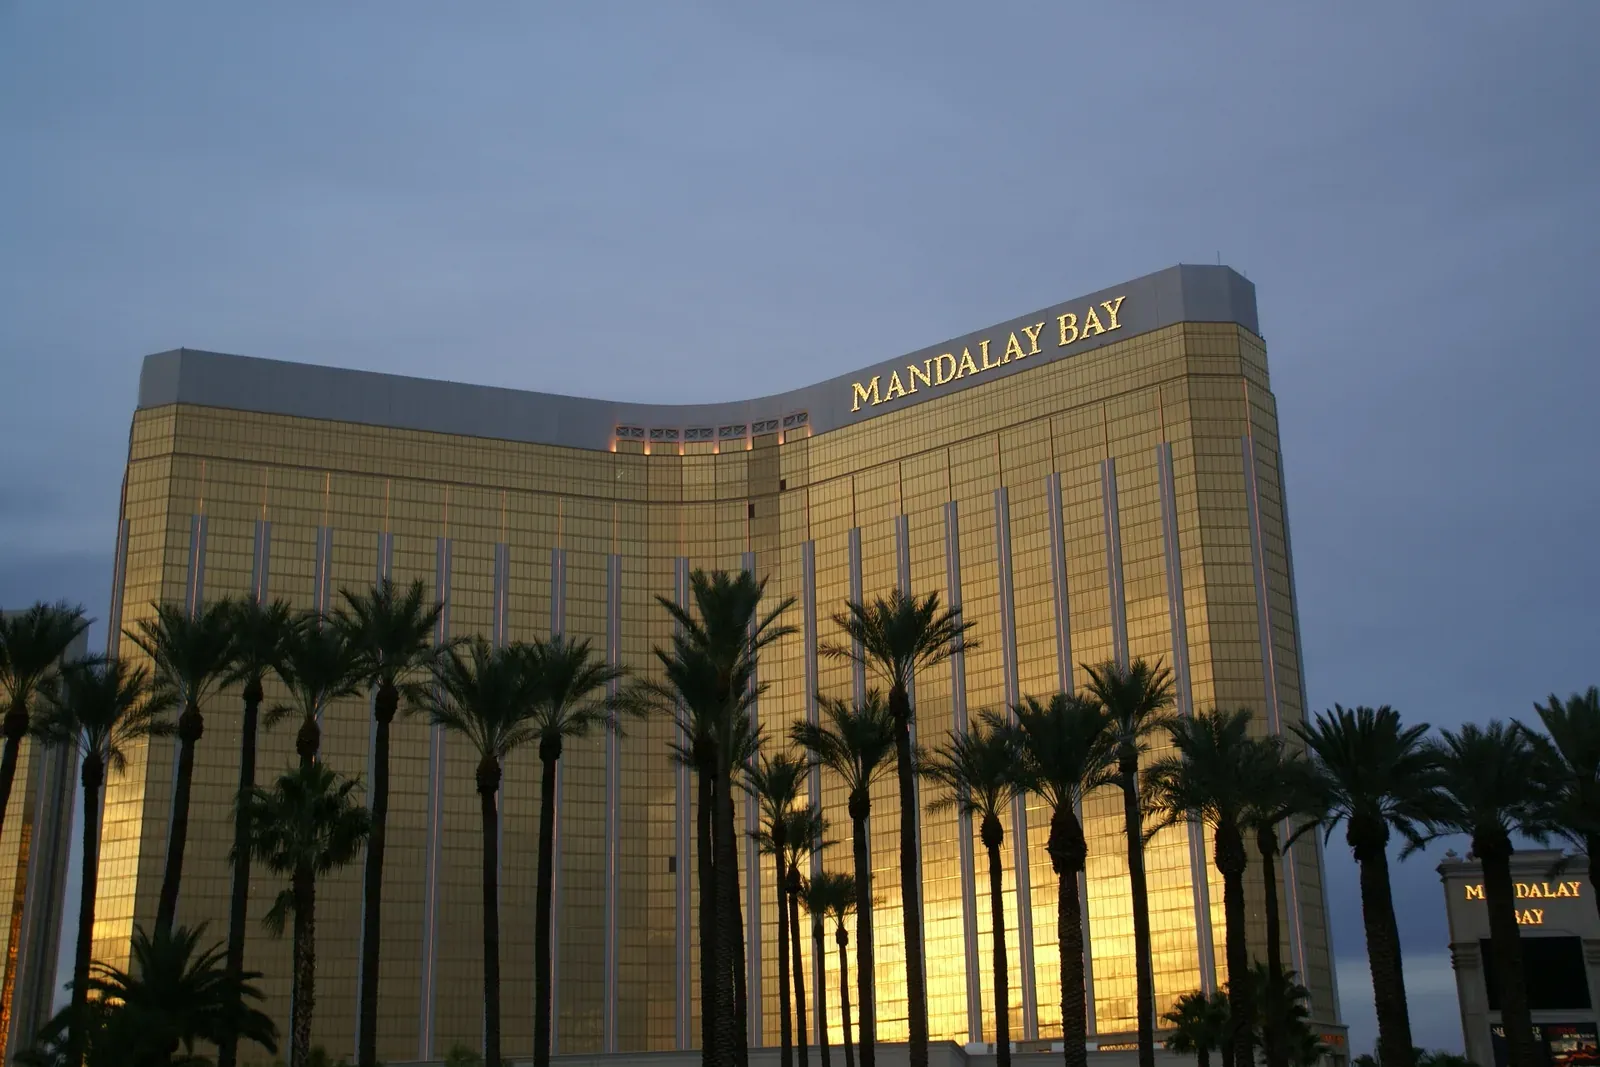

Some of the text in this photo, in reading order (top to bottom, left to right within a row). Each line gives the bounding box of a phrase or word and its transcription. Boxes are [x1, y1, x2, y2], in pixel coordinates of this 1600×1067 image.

[850, 295, 1126, 413] MANDALAY BAY
[1465, 881, 1581, 900] MDALAY
